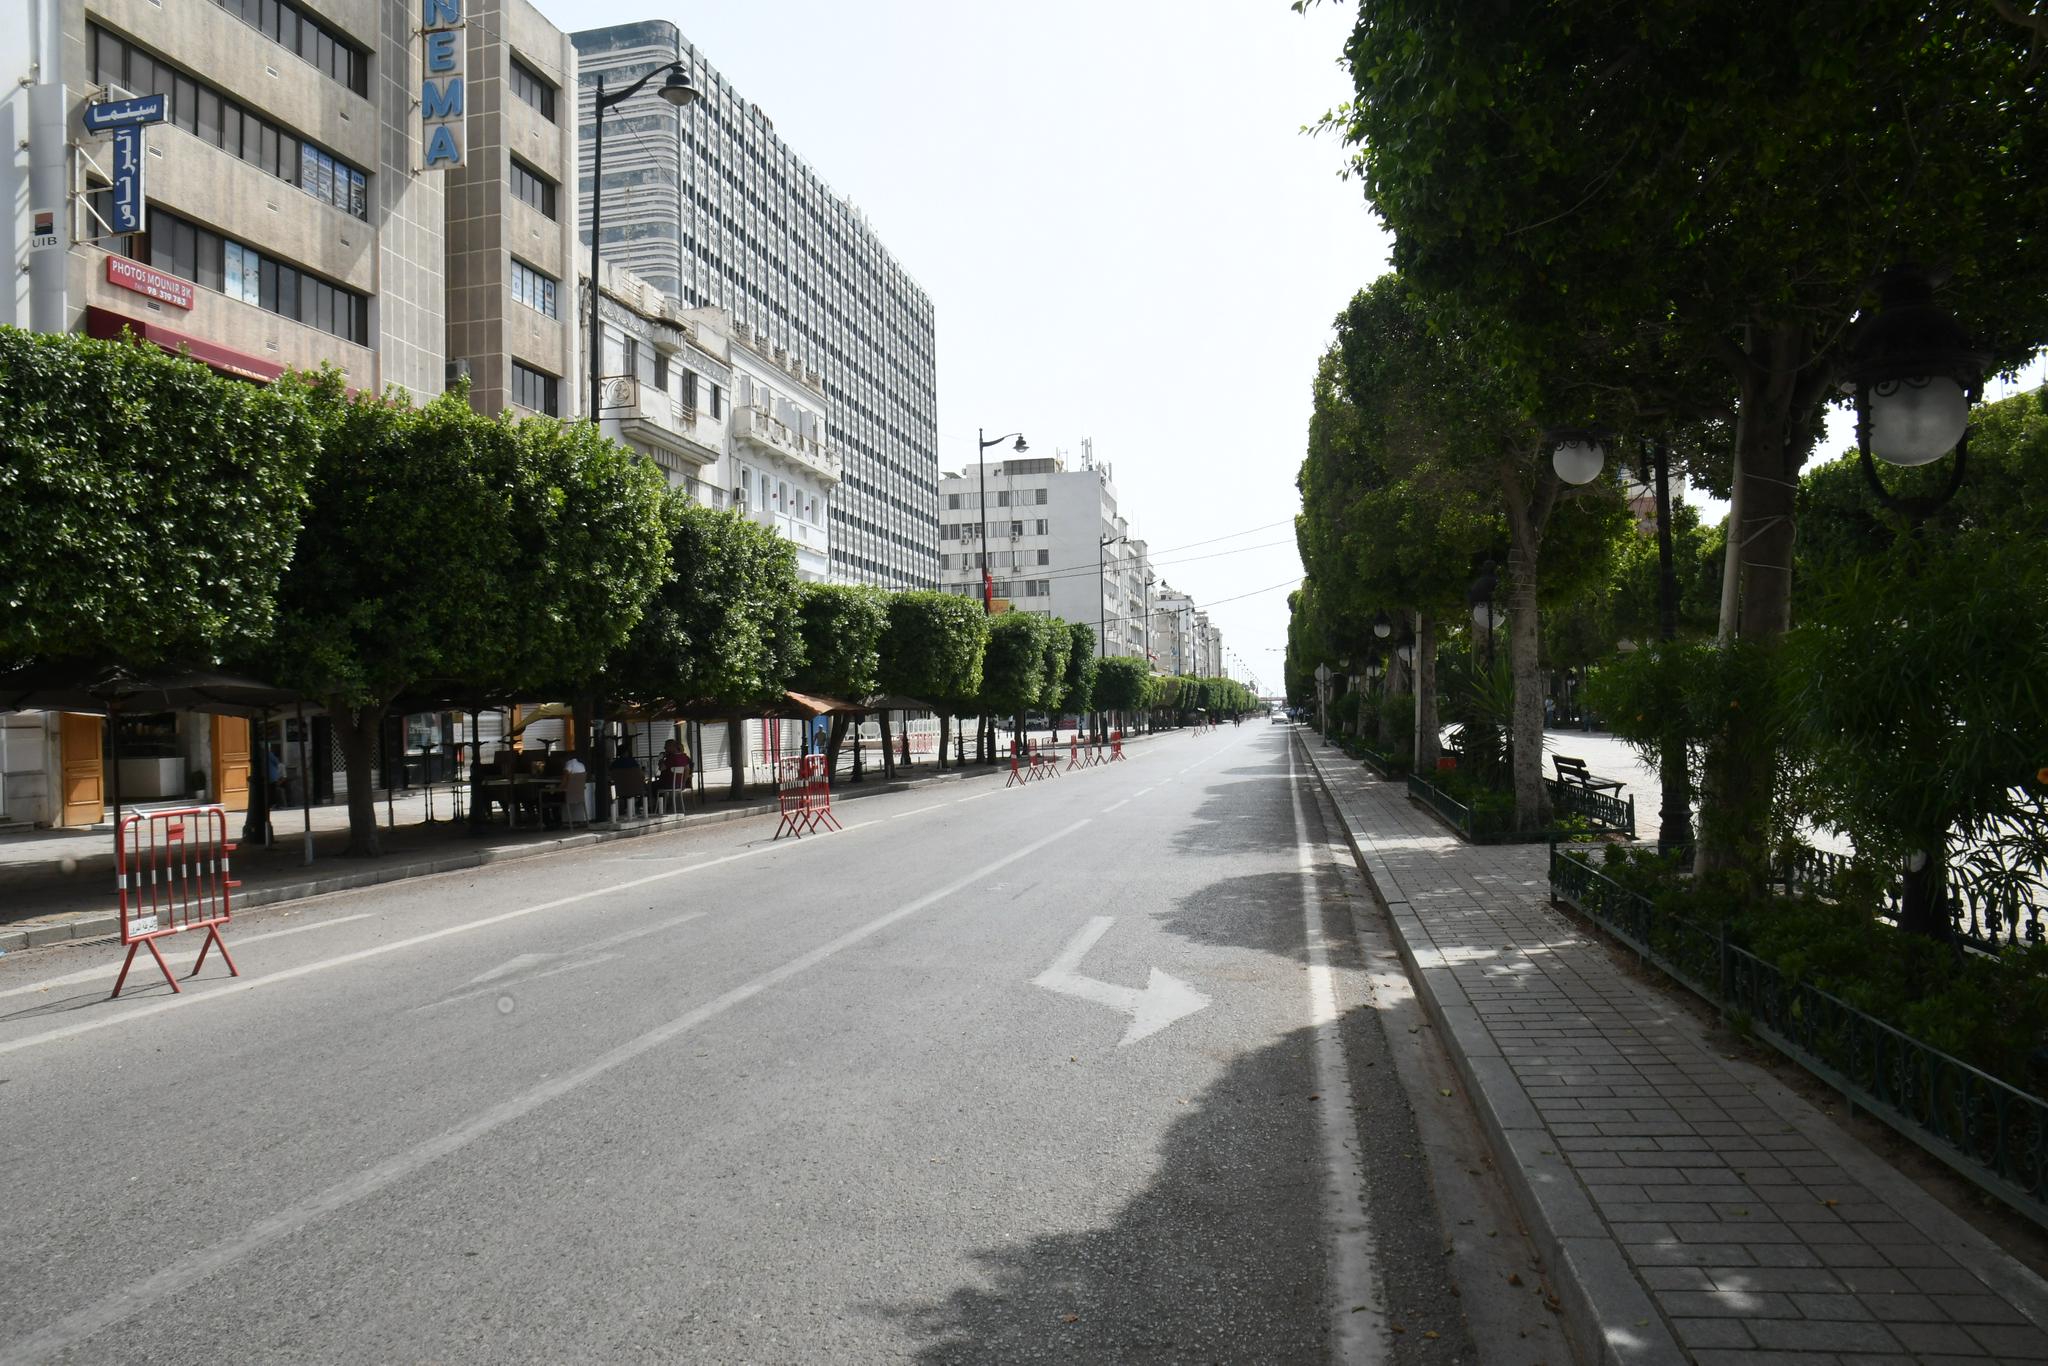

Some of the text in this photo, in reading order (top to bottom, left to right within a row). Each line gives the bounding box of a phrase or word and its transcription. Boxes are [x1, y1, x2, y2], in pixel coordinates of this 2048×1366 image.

[93, 102, 157, 122] سينما
[32, 236, 57, 248] UIB
[112, 260, 146, 282] PHOTOS
[147, 274, 181, 295] MOUNIR
